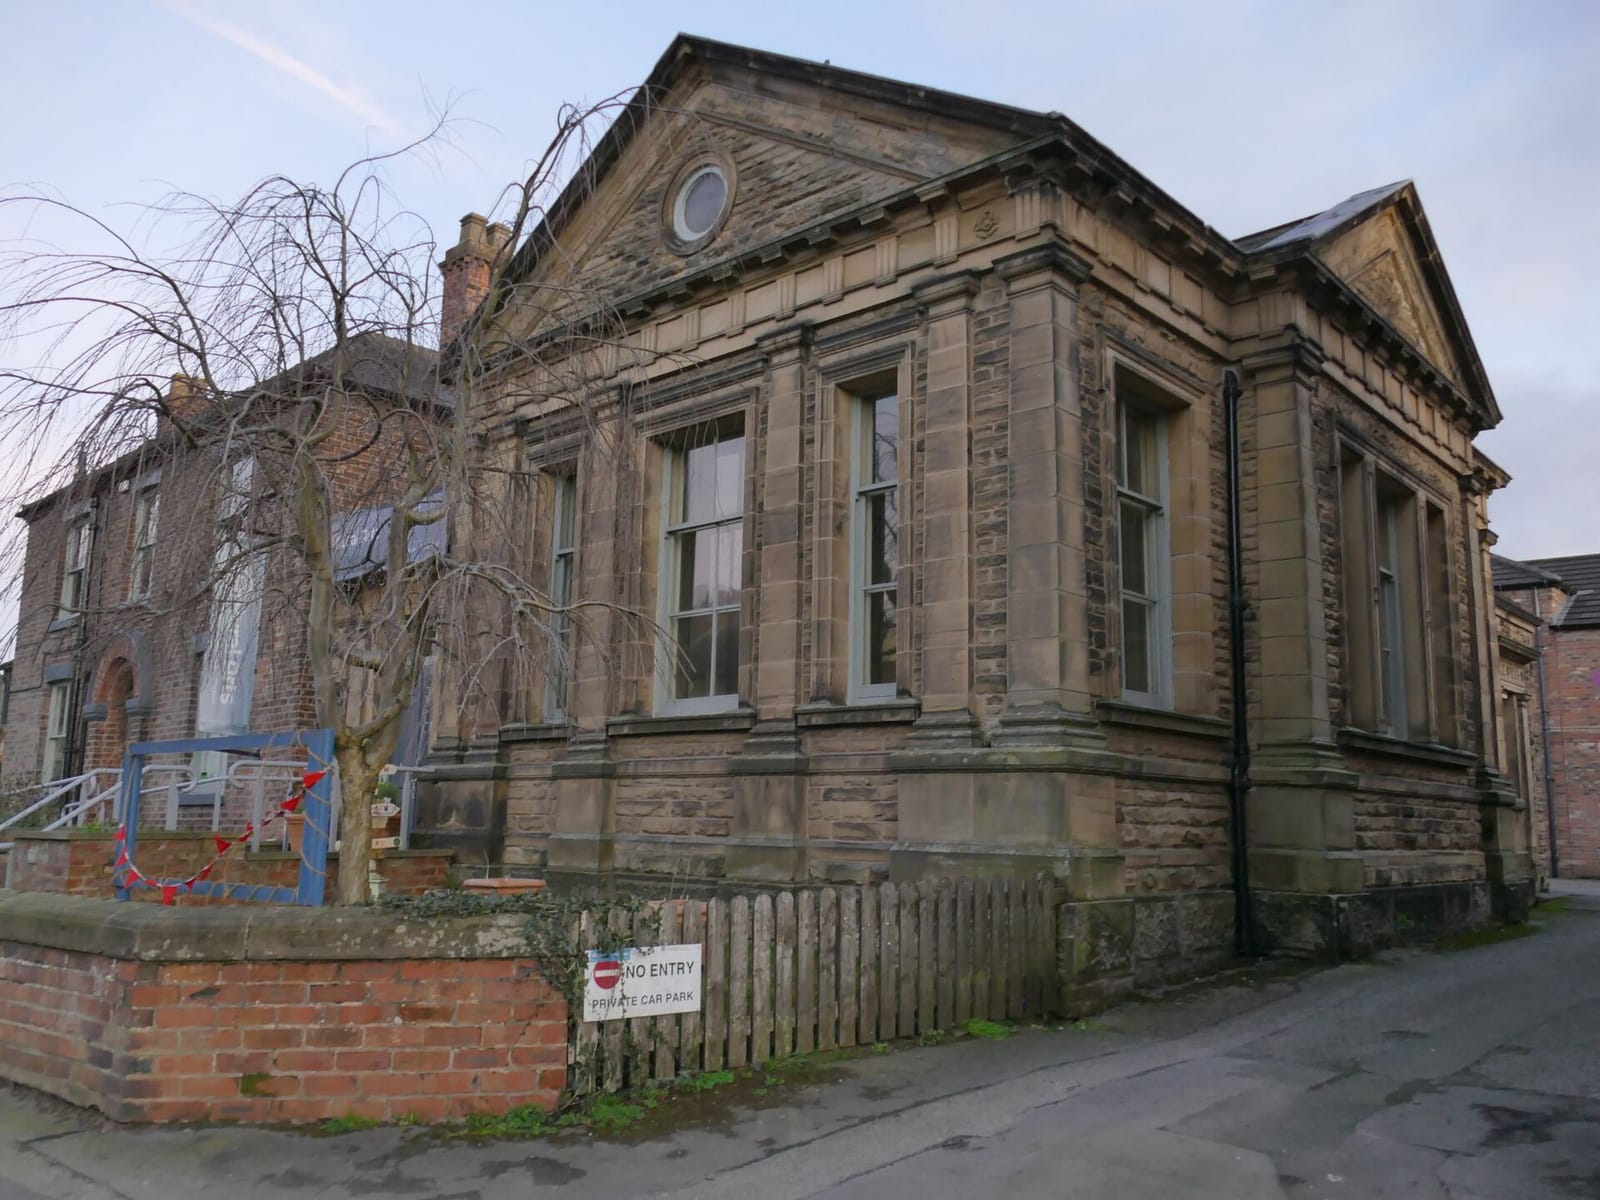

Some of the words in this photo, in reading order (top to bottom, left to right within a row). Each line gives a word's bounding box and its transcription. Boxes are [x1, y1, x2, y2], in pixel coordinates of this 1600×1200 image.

[626, 964, 646, 979] NO
[650, 961, 694, 977] ENTRY
[592, 996, 638, 1009] PRIVATE
[640, 994, 662, 1005] CAR
[665, 992, 693, 1003] PARK
